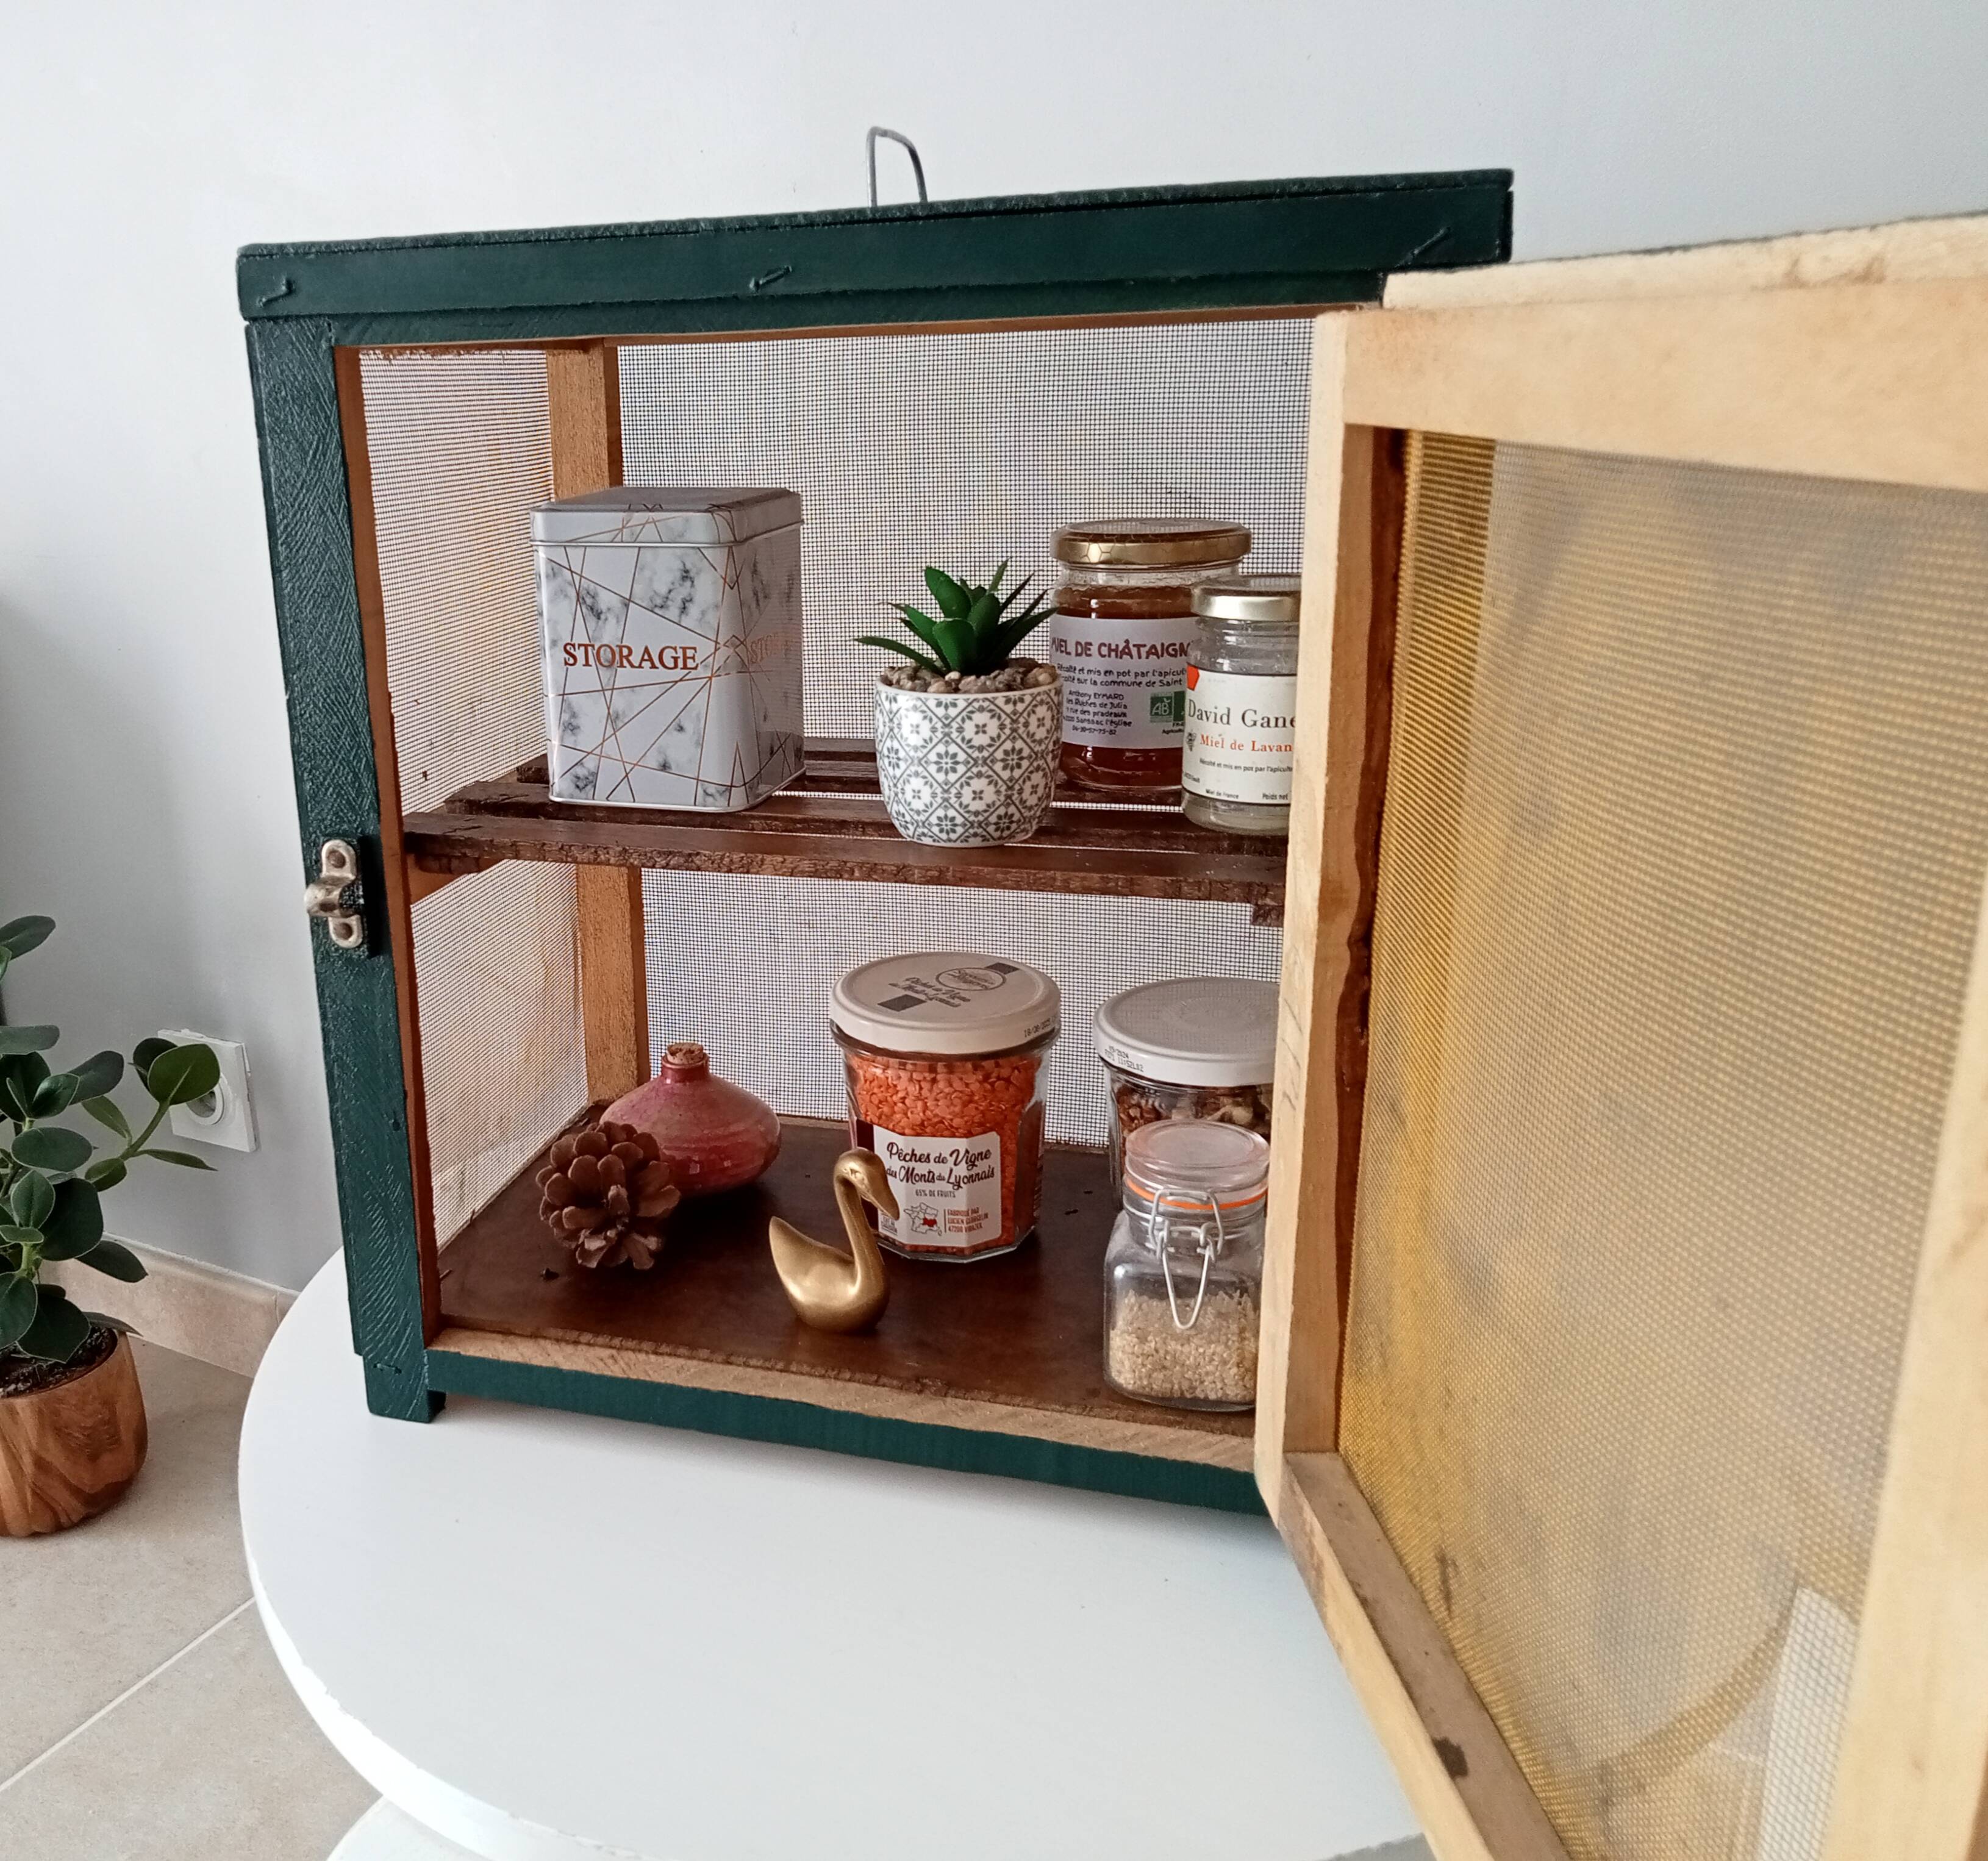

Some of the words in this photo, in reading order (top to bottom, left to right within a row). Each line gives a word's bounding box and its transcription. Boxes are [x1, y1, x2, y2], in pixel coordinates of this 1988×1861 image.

[563, 643, 699, 670] STORAGE
[1075, 641, 1093, 657] DE
[1087, 668, 1101, 676] mis
[1117, 669, 1131, 679] pot
[1134, 671, 1150, 679] par
[1159, 678, 1182, 687] Saint
[1151, 702, 1169, 715] AB
[1189, 699, 1231, 725] David
[1200, 734, 1224, 748] Miel
[1230, 739, 1244, 751] de
[1251, 740, 1292, 752] Lavan
[887, 1142, 931, 1163] Pêches
[934, 1152, 948, 1163] de
[949, 1148, 992, 1171] Vigne
[898, 1165, 935, 1185] Monts
[936, 1173, 945, 1181] du
[946, 1165, 995, 1190] Lyonnais
